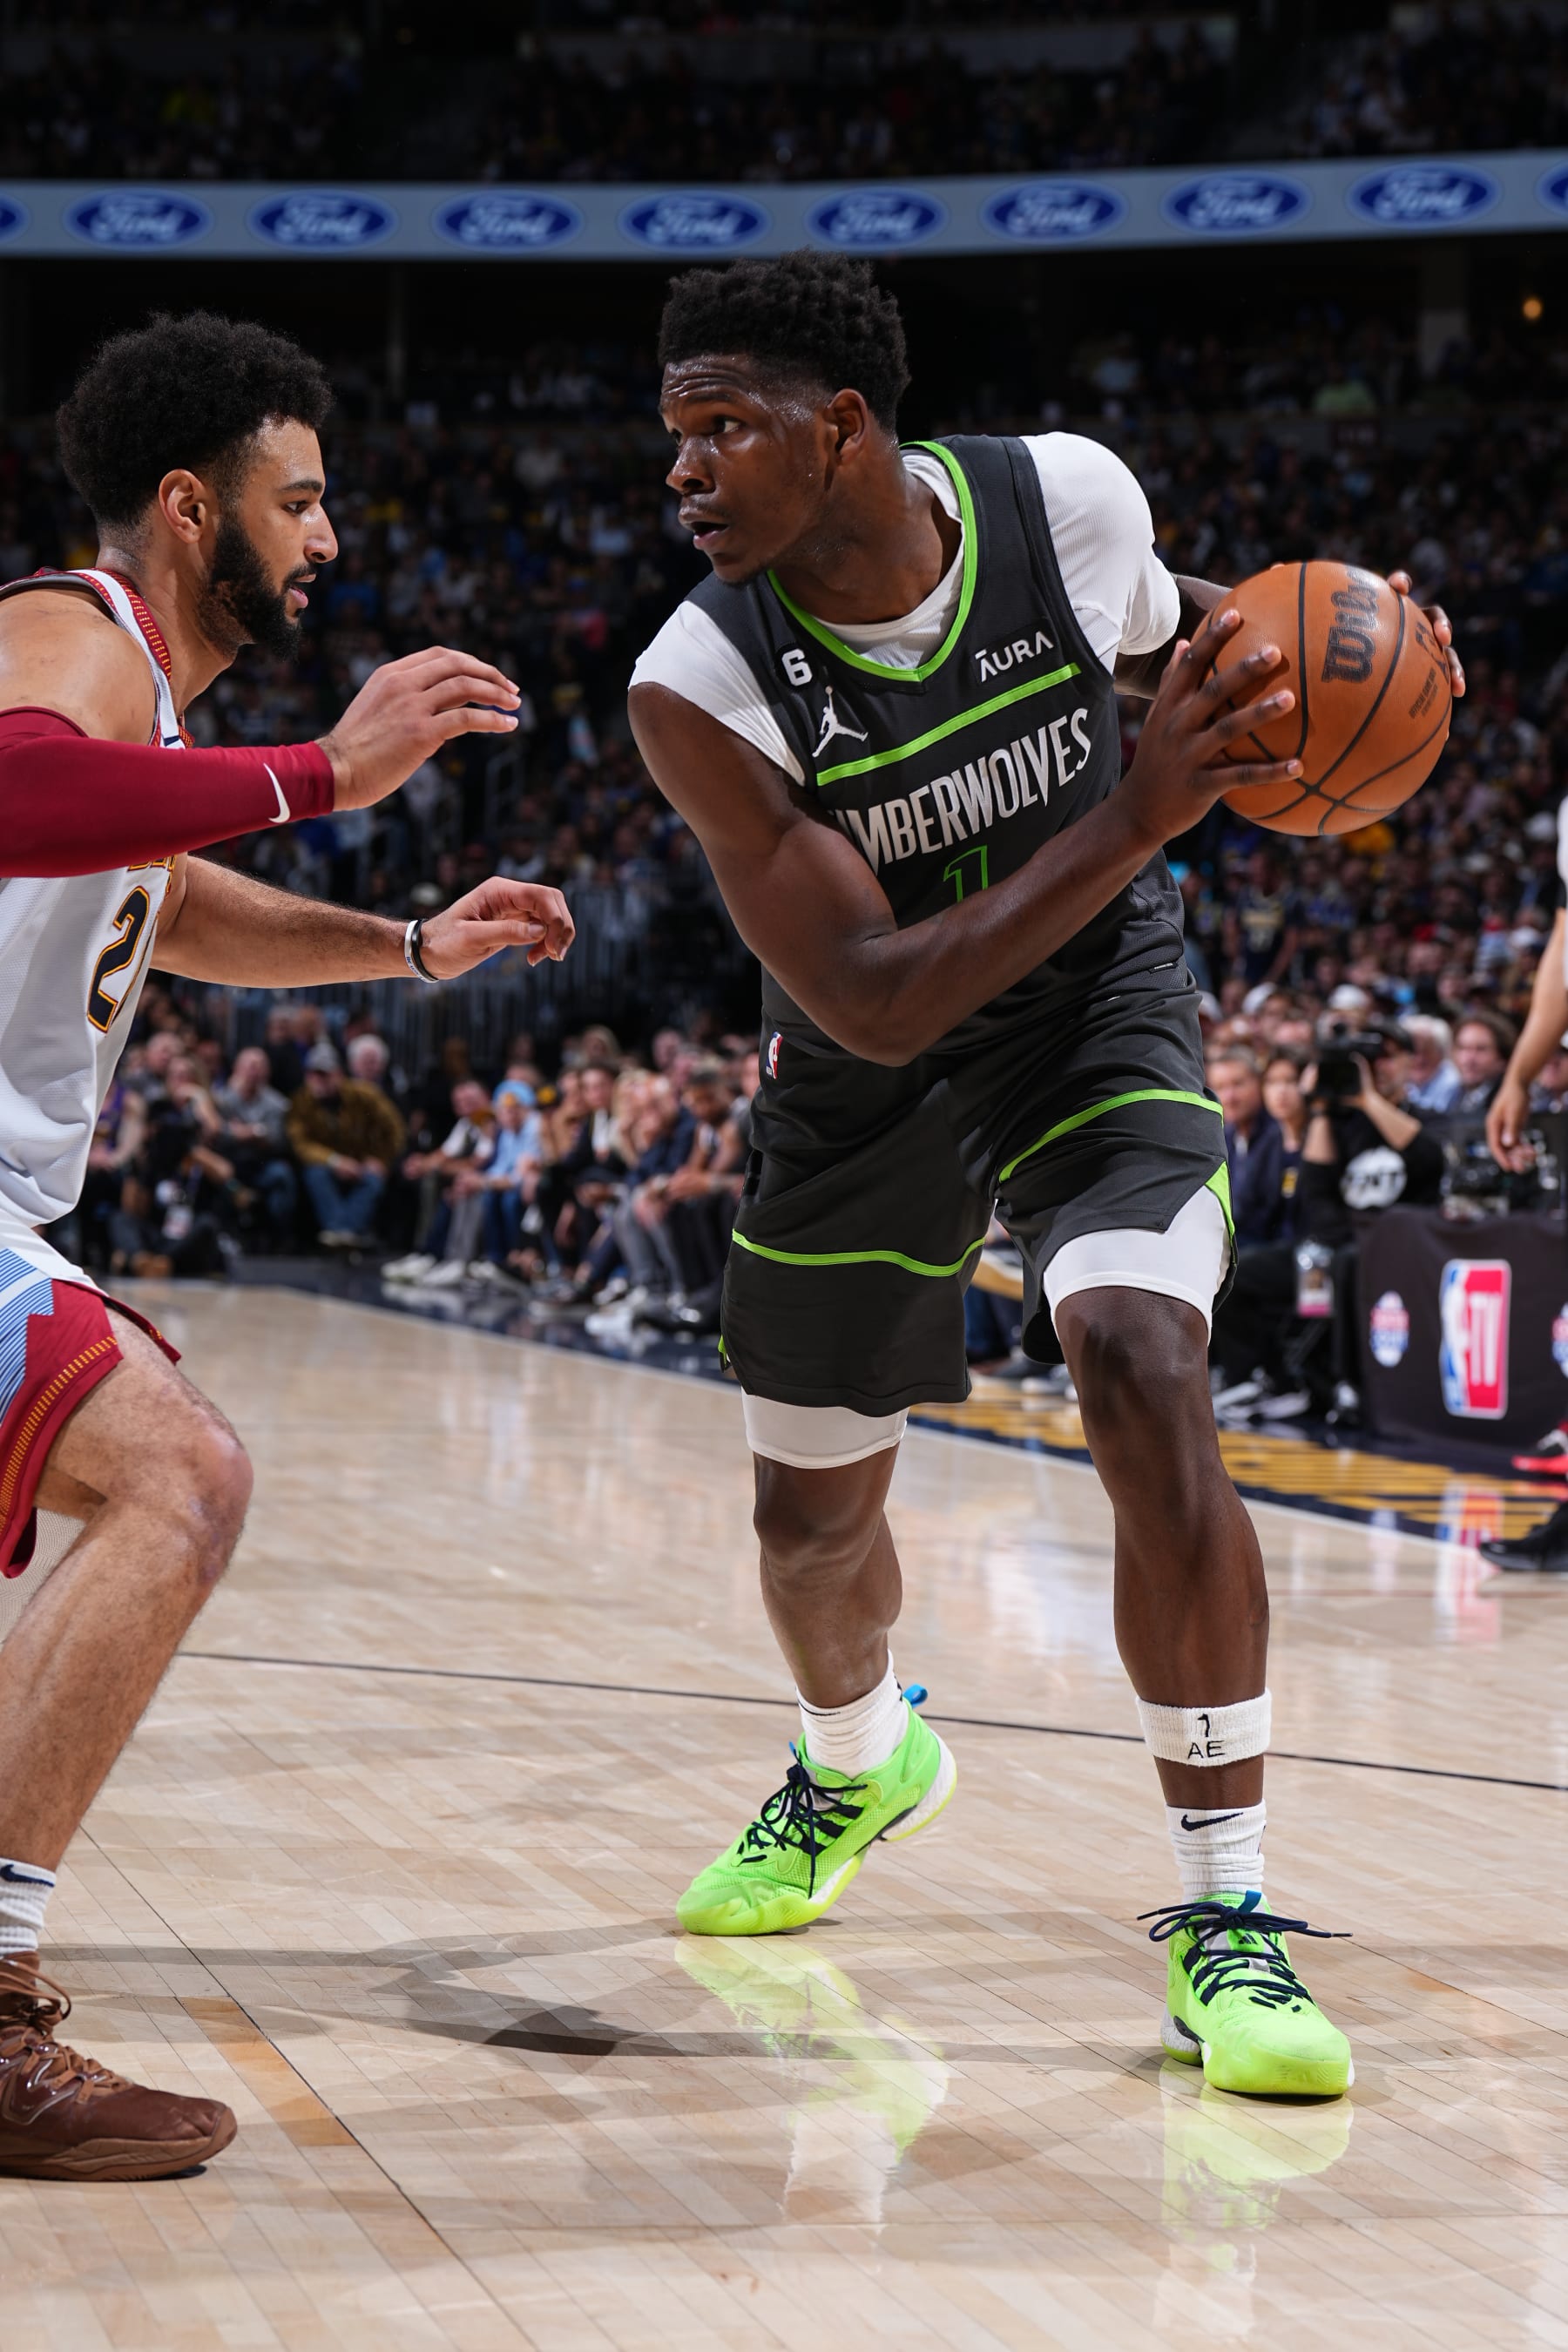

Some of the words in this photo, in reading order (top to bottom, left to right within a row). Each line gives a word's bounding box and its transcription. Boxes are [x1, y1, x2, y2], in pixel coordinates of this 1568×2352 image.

[91, 195, 184, 241] Ford
[829, 193, 922, 240] Ford
[1007, 188, 1100, 235] Ford
[1188, 180, 1282, 226] Ford
[1374, 172, 1470, 218] Ford
[274, 195, 369, 242] Ford
[460, 197, 556, 242] Ford
[646, 197, 741, 243] Ford
[781, 648, 813, 686] 6
[1197, 1713, 1211, 1738] 1
[1187, 1740, 1226, 1760] AE
